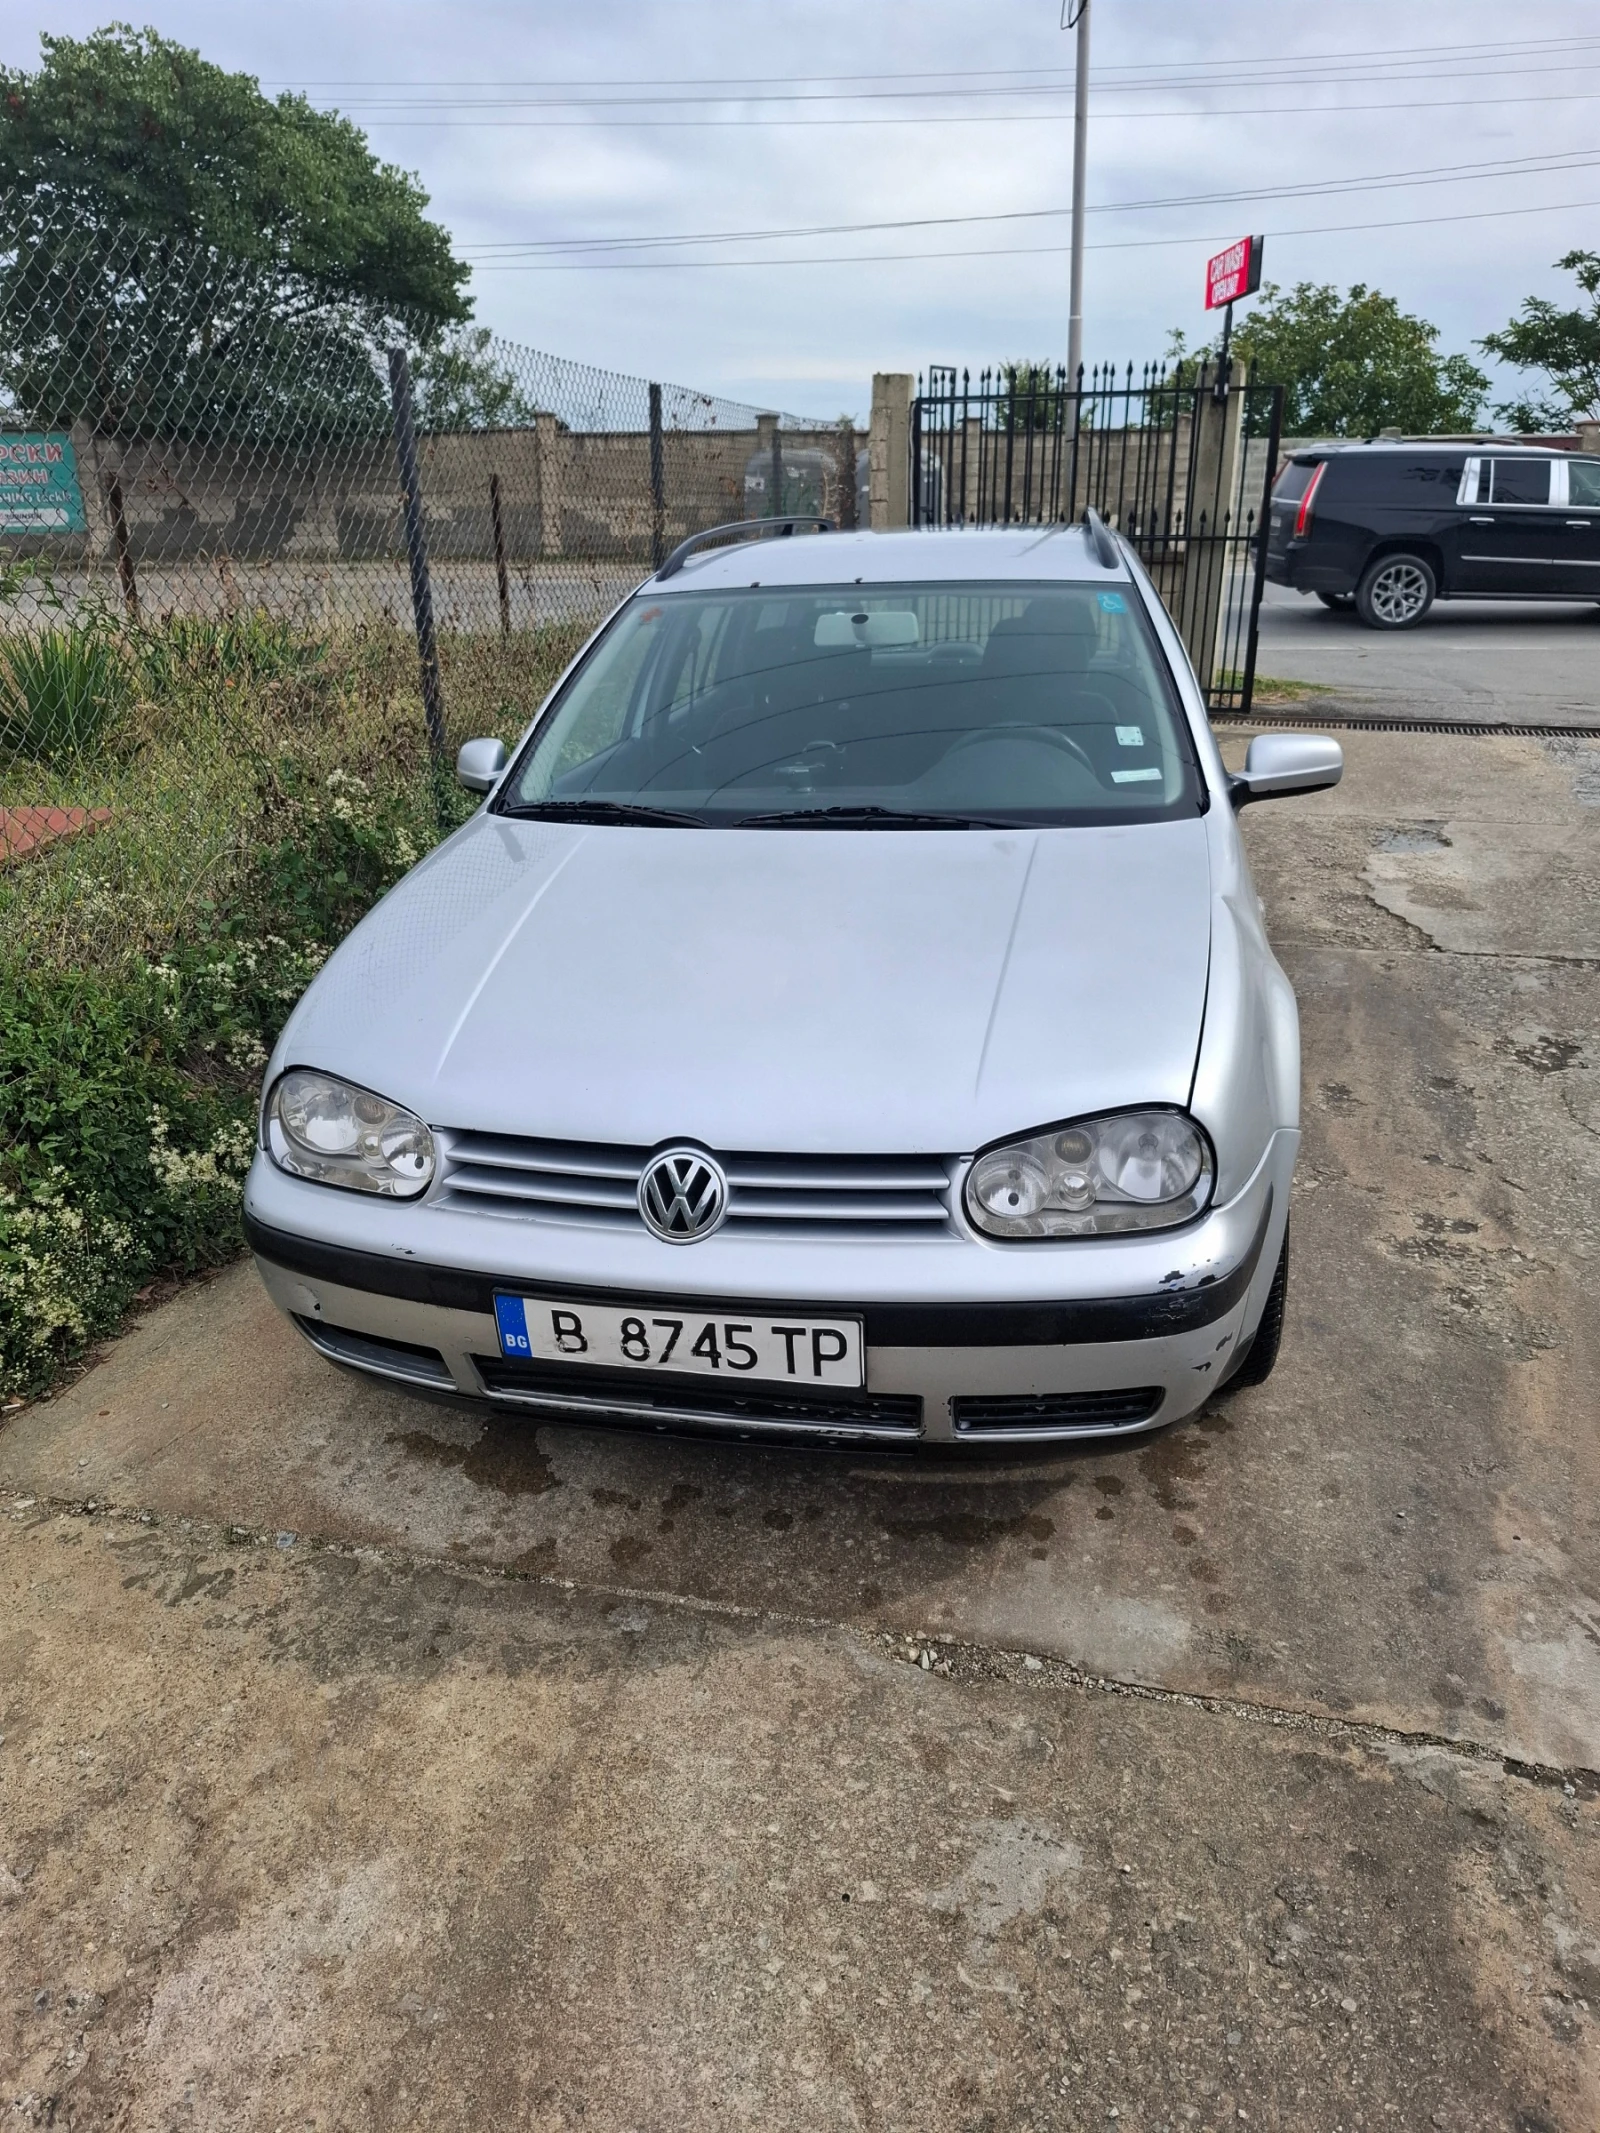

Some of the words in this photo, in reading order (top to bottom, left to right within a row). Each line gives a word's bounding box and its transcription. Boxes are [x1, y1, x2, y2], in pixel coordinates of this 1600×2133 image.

[641, 1152, 723, 1238] VW
[505, 1333, 528, 1349] BG
[619, 1316, 758, 1371] 8745
[771, 1326, 847, 1376] TP
